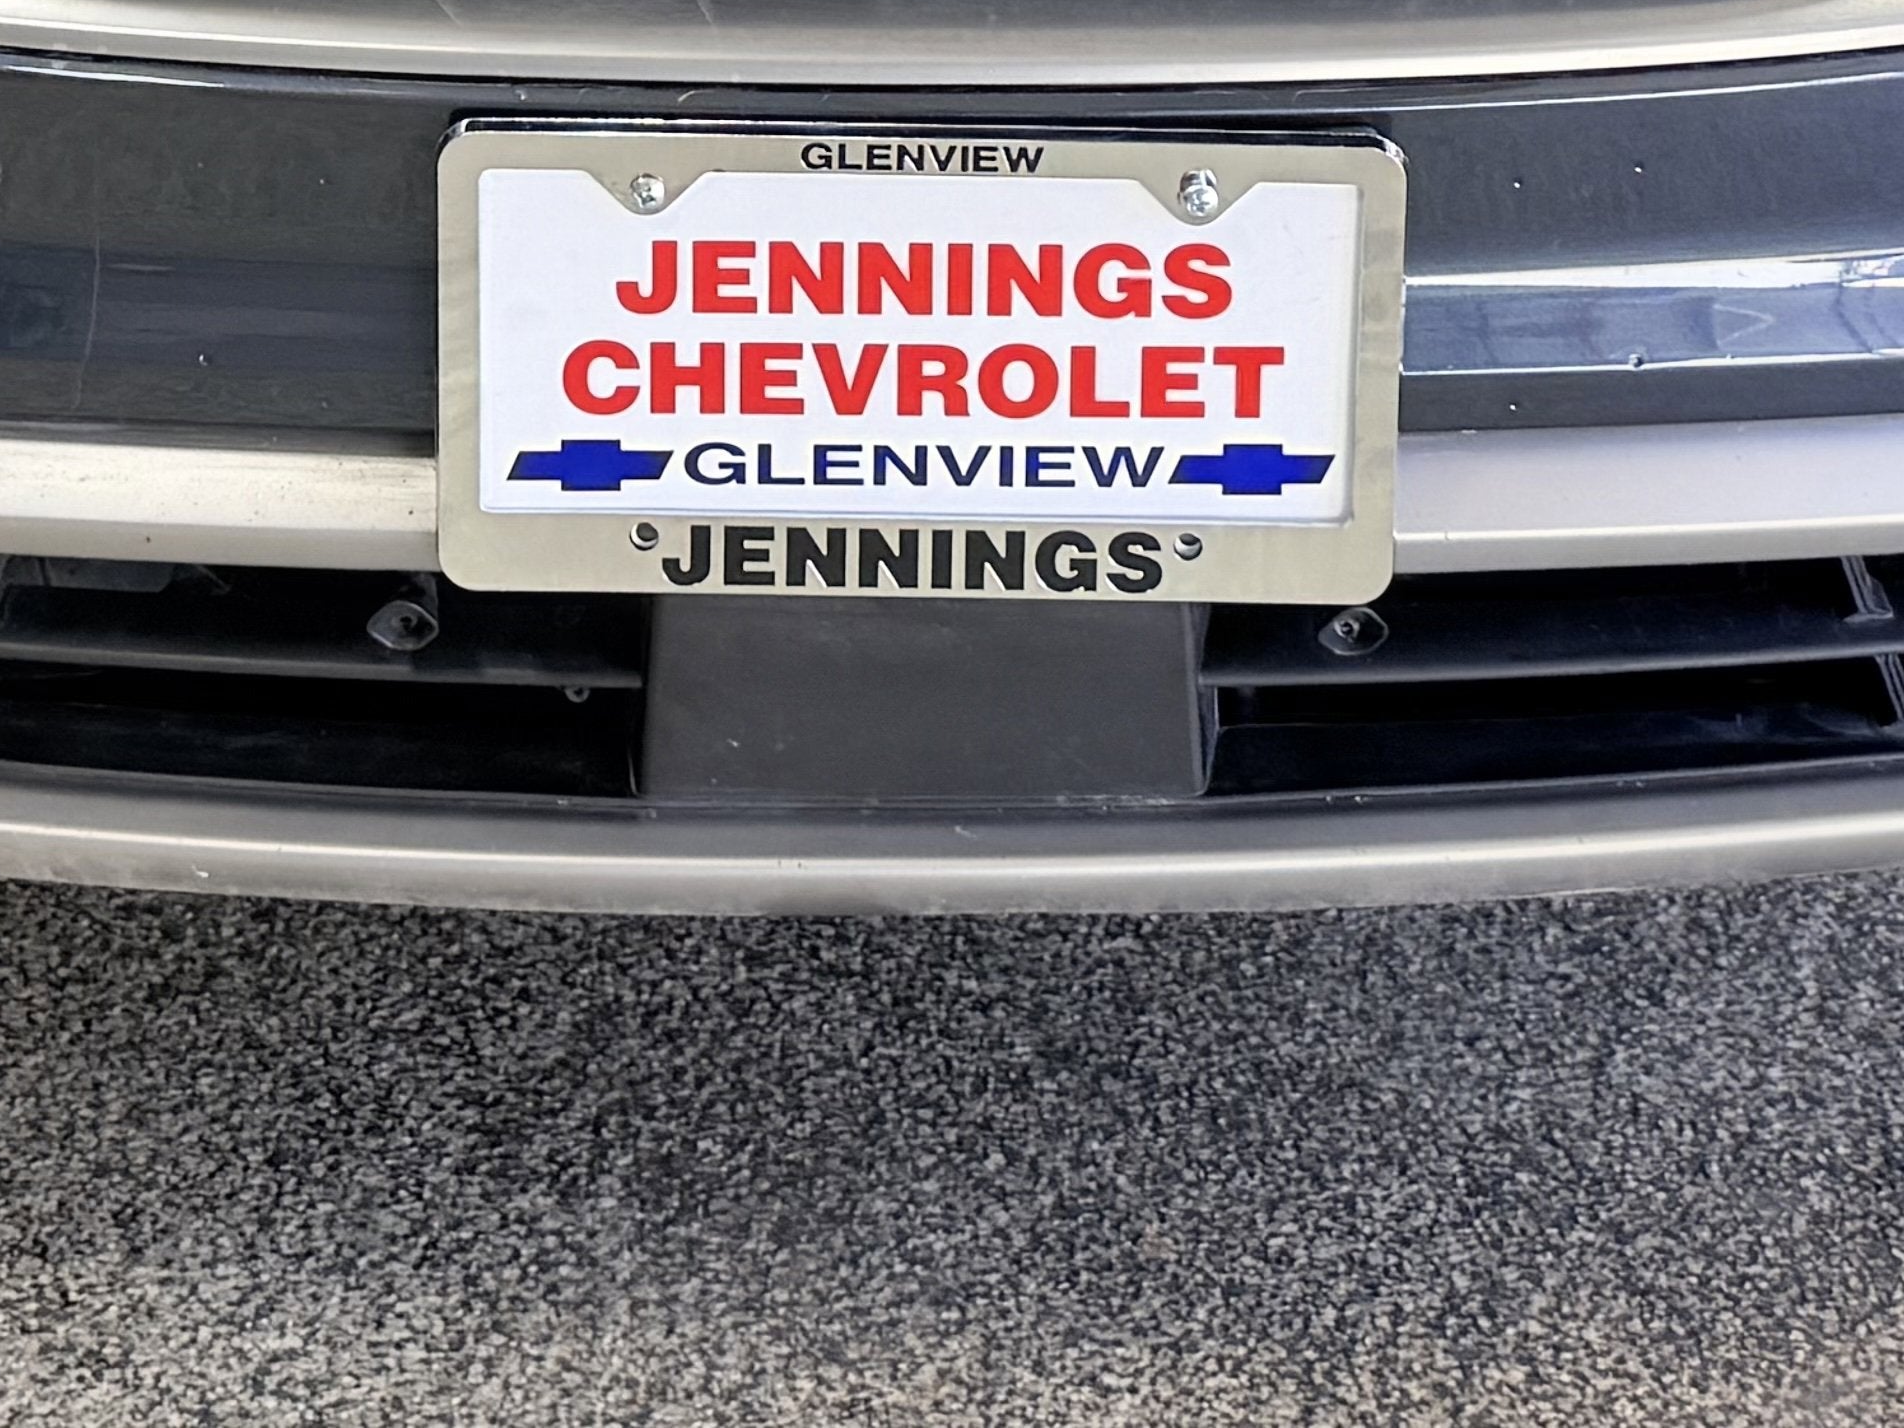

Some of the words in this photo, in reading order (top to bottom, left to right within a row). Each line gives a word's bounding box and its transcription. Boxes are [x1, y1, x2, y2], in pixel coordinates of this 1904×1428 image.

[799, 141, 1045, 175] GLENVIEW
[615, 239, 1234, 321] JENNINGS
[561, 338, 1286, 420] CHEVROLET
[682, 441, 1166, 489] GLENVIEW
[660, 523, 1164, 595] JENNINGS
